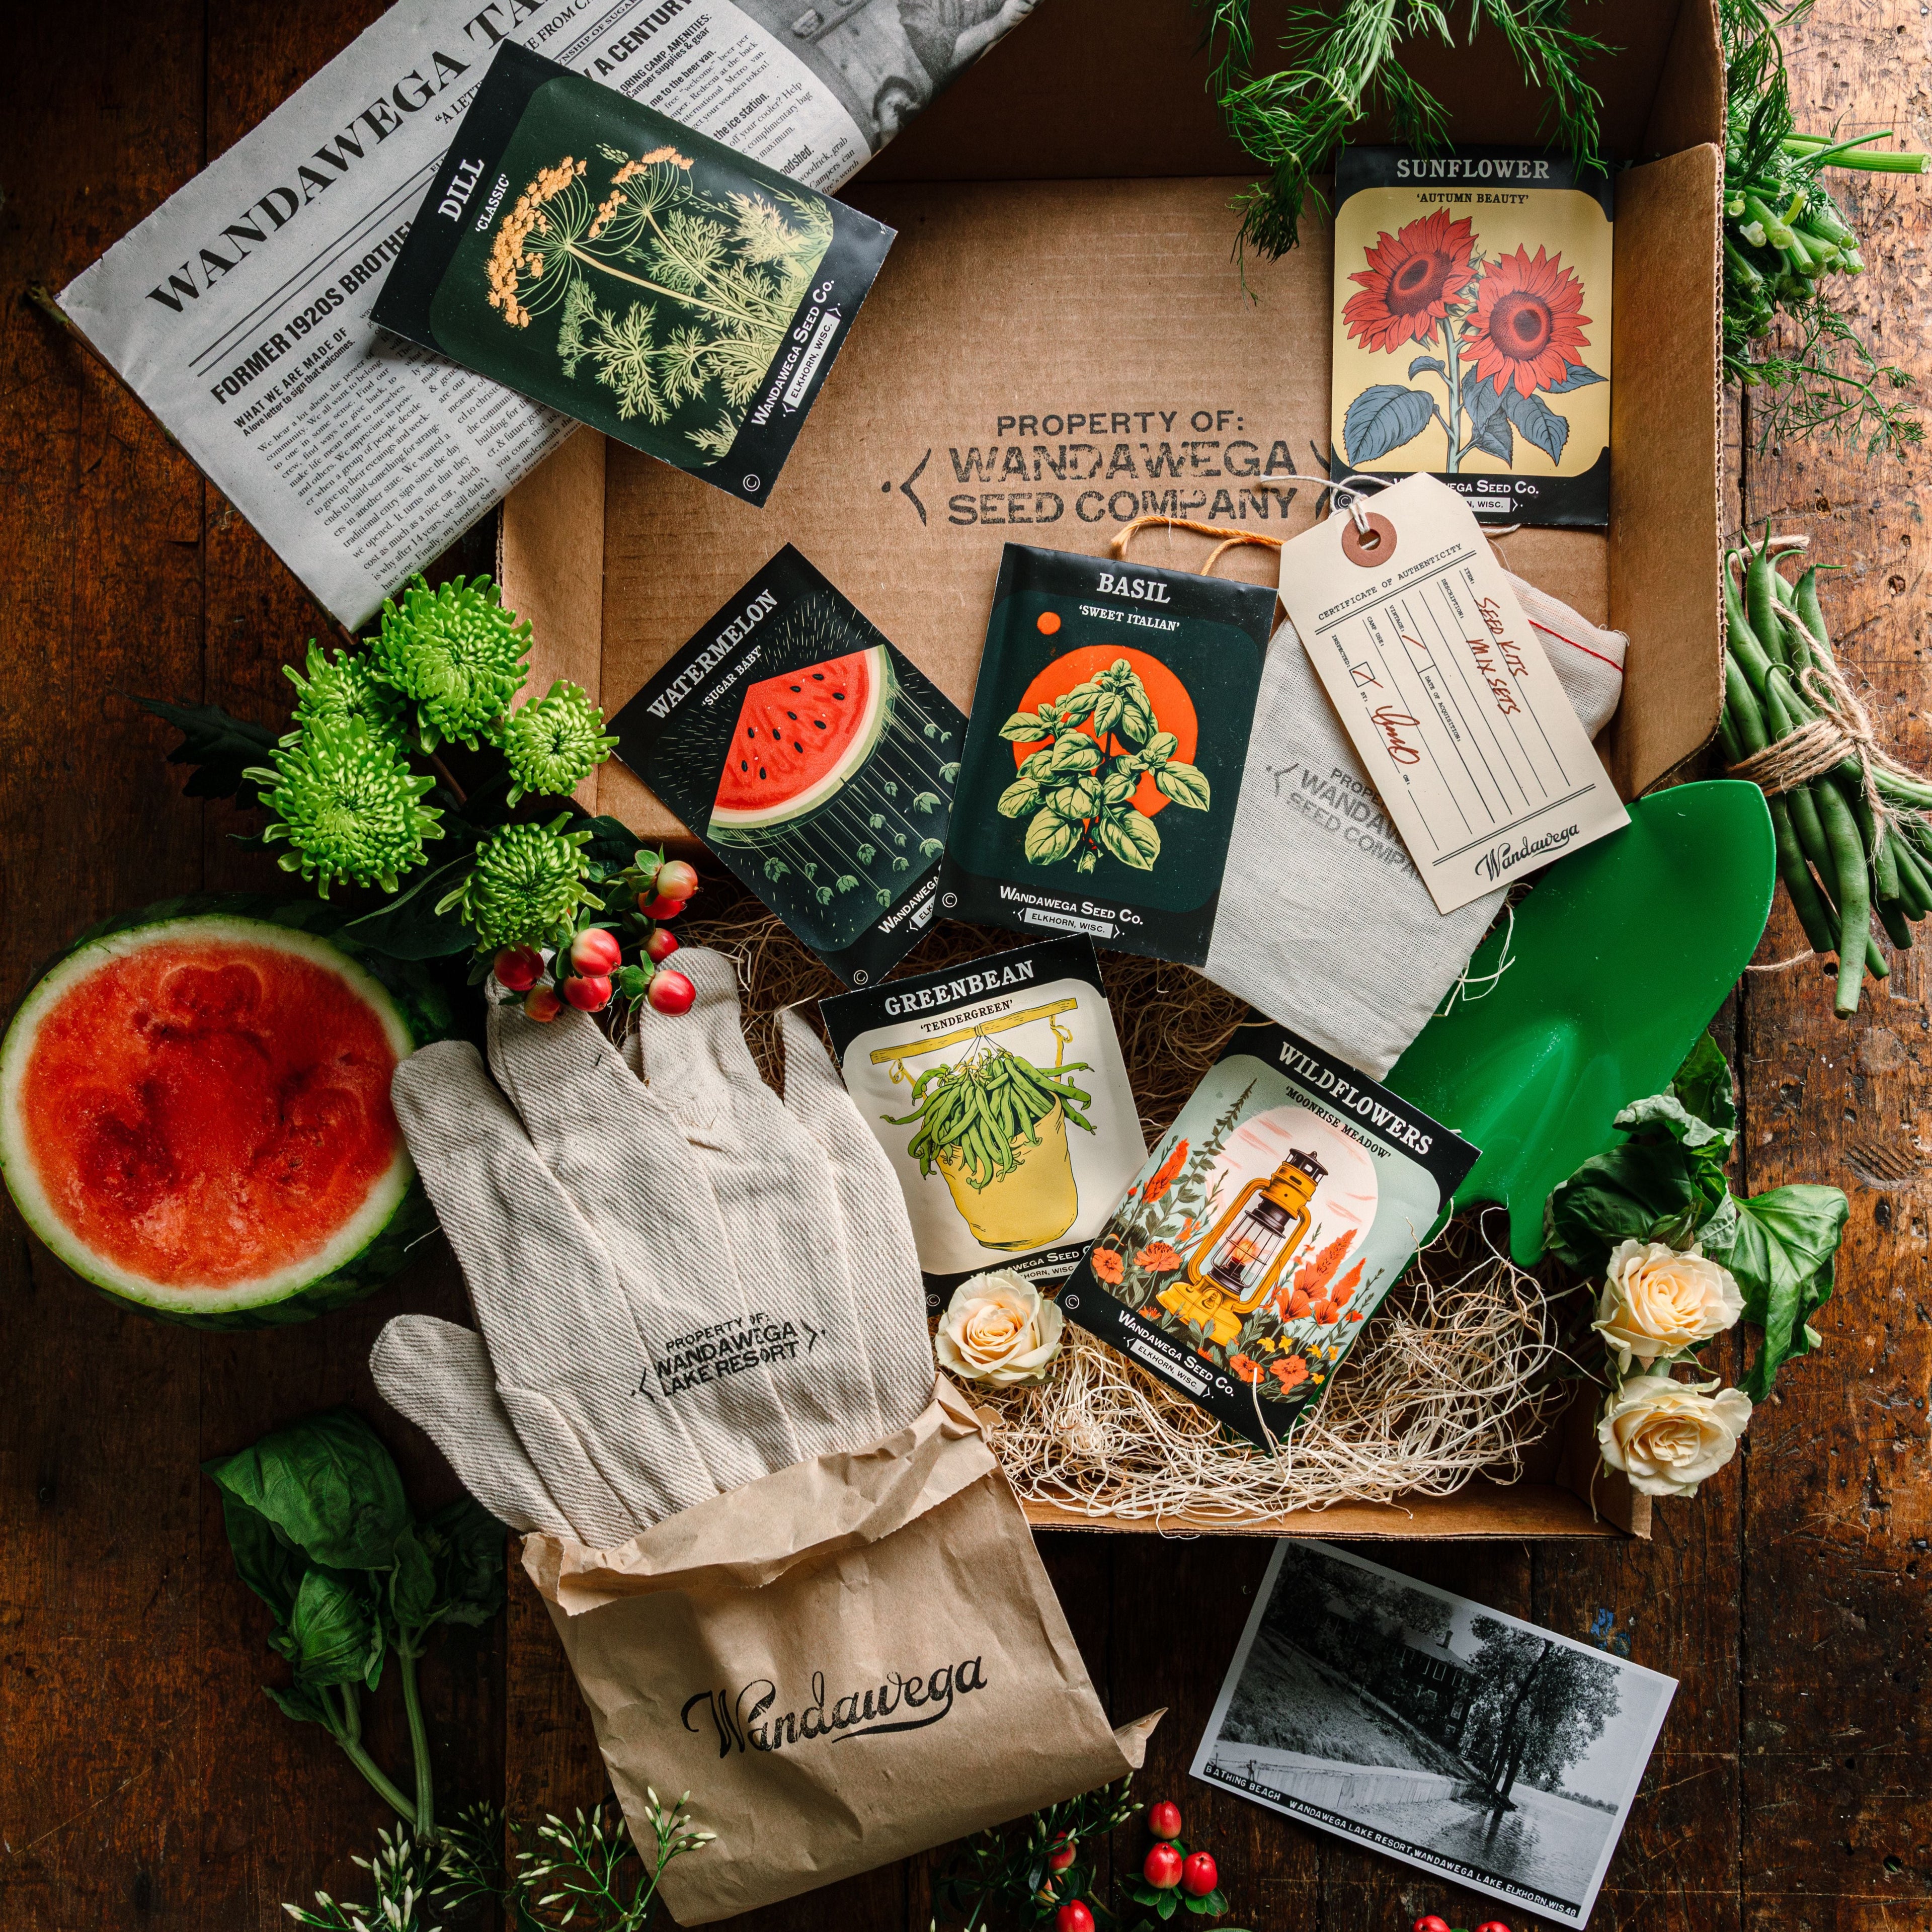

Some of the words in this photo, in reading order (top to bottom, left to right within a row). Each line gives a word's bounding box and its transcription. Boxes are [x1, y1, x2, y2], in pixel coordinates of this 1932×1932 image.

[536, 6, 576, 42] FROM
[592, 24, 604, 35] OF
[593, 57, 615, 77] A
[620, 69, 647, 95] ORING
[668, 14, 711, 52] AMENITIES:
[652, 45, 688, 77] supplies
[682, 39, 695, 53] &
[689, 25, 712, 47] gear
[665, 96, 679, 109] free
[679, 61, 714, 92] “welcome”
[717, 47, 734, 61] beer
[737, 35, 748, 47] per
[690, 75, 719, 100] Redeem
[728, 57, 739, 67] the
[739, 43, 758, 57] back
[725, 66, 747, 83] Metro
[751, 52, 766, 62] van.
[661, 88, 671, 96] to
[669, 77, 684, 88] the
[681, 62, 700, 77] beer
[699, 51, 716, 63] van.
[692, 119, 703, 132] get
[703, 105, 719, 121] your
[719, 82, 747, 105] wooden
[746, 61, 769, 82] token!
[713, 127, 729, 140] the
[726, 117, 741, 129] ice
[739, 94, 769, 118] station.
[730, 134, 740, 150] off
[740, 121, 756, 139] your
[758, 97, 782, 122] cooler?
[782, 83, 801, 99] Help
[748, 106, 798, 148] complimentary
[795, 92, 813, 105] bag
[760, 127, 795, 157] maximum.
[146, 51, 471, 313] WANDAWEGA
[463, 0, 548, 49] TA
[832, 137, 847, 156] grab
[438, 159, 485, 221] DILL
[1397, 159, 1549, 179] SUNFLOWER
[210, 334, 292, 405] FORMER
[285, 288, 344, 341] 1920S
[339, 221, 412, 295] BROTHE
[302, 366, 323, 385] that
[316, 336, 357, 373] welcomes.
[791, 354, 819, 398] ELKHORN,
[815, 325, 832, 349] WISC.
[234, 400, 265, 428] WHAT
[264, 385, 283, 403] WE
[282, 367, 304, 389] ARE
[302, 340, 334, 369] MADE
[333, 327, 347, 342] OF
[279, 391, 292, 406] to
[287, 378, 308, 398] sign
[246, 414, 266, 434] love
[260, 397, 285, 422] letter
[998, 411, 1177, 437] PROPERTY
[1190, 410, 1243, 432] OF:
[240, 425, 253, 439] A
[949, 440, 1297, 482] WANDAWEGA
[344, 513, 380, 547] traditional
[380, 499, 398, 515] entry
[399, 484, 415, 499] sign
[415, 467, 434, 482] since
[434, 456, 445, 468] the
[447, 446, 460, 456] day
[948, 492, 1064, 525] SEED
[1075, 486, 1298, 523] COMPANY
[1097, 573, 1170, 603] BASIL
[1319, 587, 1377, 620] CERTIFICATE
[1382, 579, 1392, 588] OF
[1398, 543, 1462, 580] AUTHENTICITY
[1465, 568, 1474, 584] ITEM:
[1390, 605, 1404, 632] VINTAGE:
[1441, 579, 1464, 618] DESCRIPTION:
[1332, 635, 1350, 667] INSPECTED:
[1367, 616, 1377, 629] CAMP
[1376, 632, 1384, 646] USE:
[1475, 598, 1503, 634] SEED
[1497, 641, 1528, 676] KITS
[647, 589, 777, 718] WATERMELON
[1466, 639, 1495, 674] MIX
[1487, 679, 1520, 714] SETS
[1425, 676, 1435, 690] DATE
[1438, 702, 1461, 742] ACQUISITION:
[1286, 791, 1341, 830] SEED
[1475, 825, 1579, 881] Wandawega
[1032, 913, 1076, 928] ELKHORN,
[1080, 922, 1104, 933] WISC.
[885, 960, 1033, 1015] GREENBEAN
[1279, 1042, 1432, 1154] WILDFLOWERS
[654, 1322, 797, 1379] WANDAWEGA
[666, 1318, 742, 1352] PROPERTY
[661, 1365, 714, 1397] LAKE
[715, 1341, 798, 1380] RESORT
[1138, 1346, 1174, 1374] ELKHORN,
[1177, 1371, 1196, 1389] WISC.
[681, 1655, 987, 1758] Wandawega
[1206, 1766, 1246, 1786] BATHING
[1290, 1801, 1346, 1828] WANDAWEGA
[1348, 1824, 1373, 1838] LAKE
